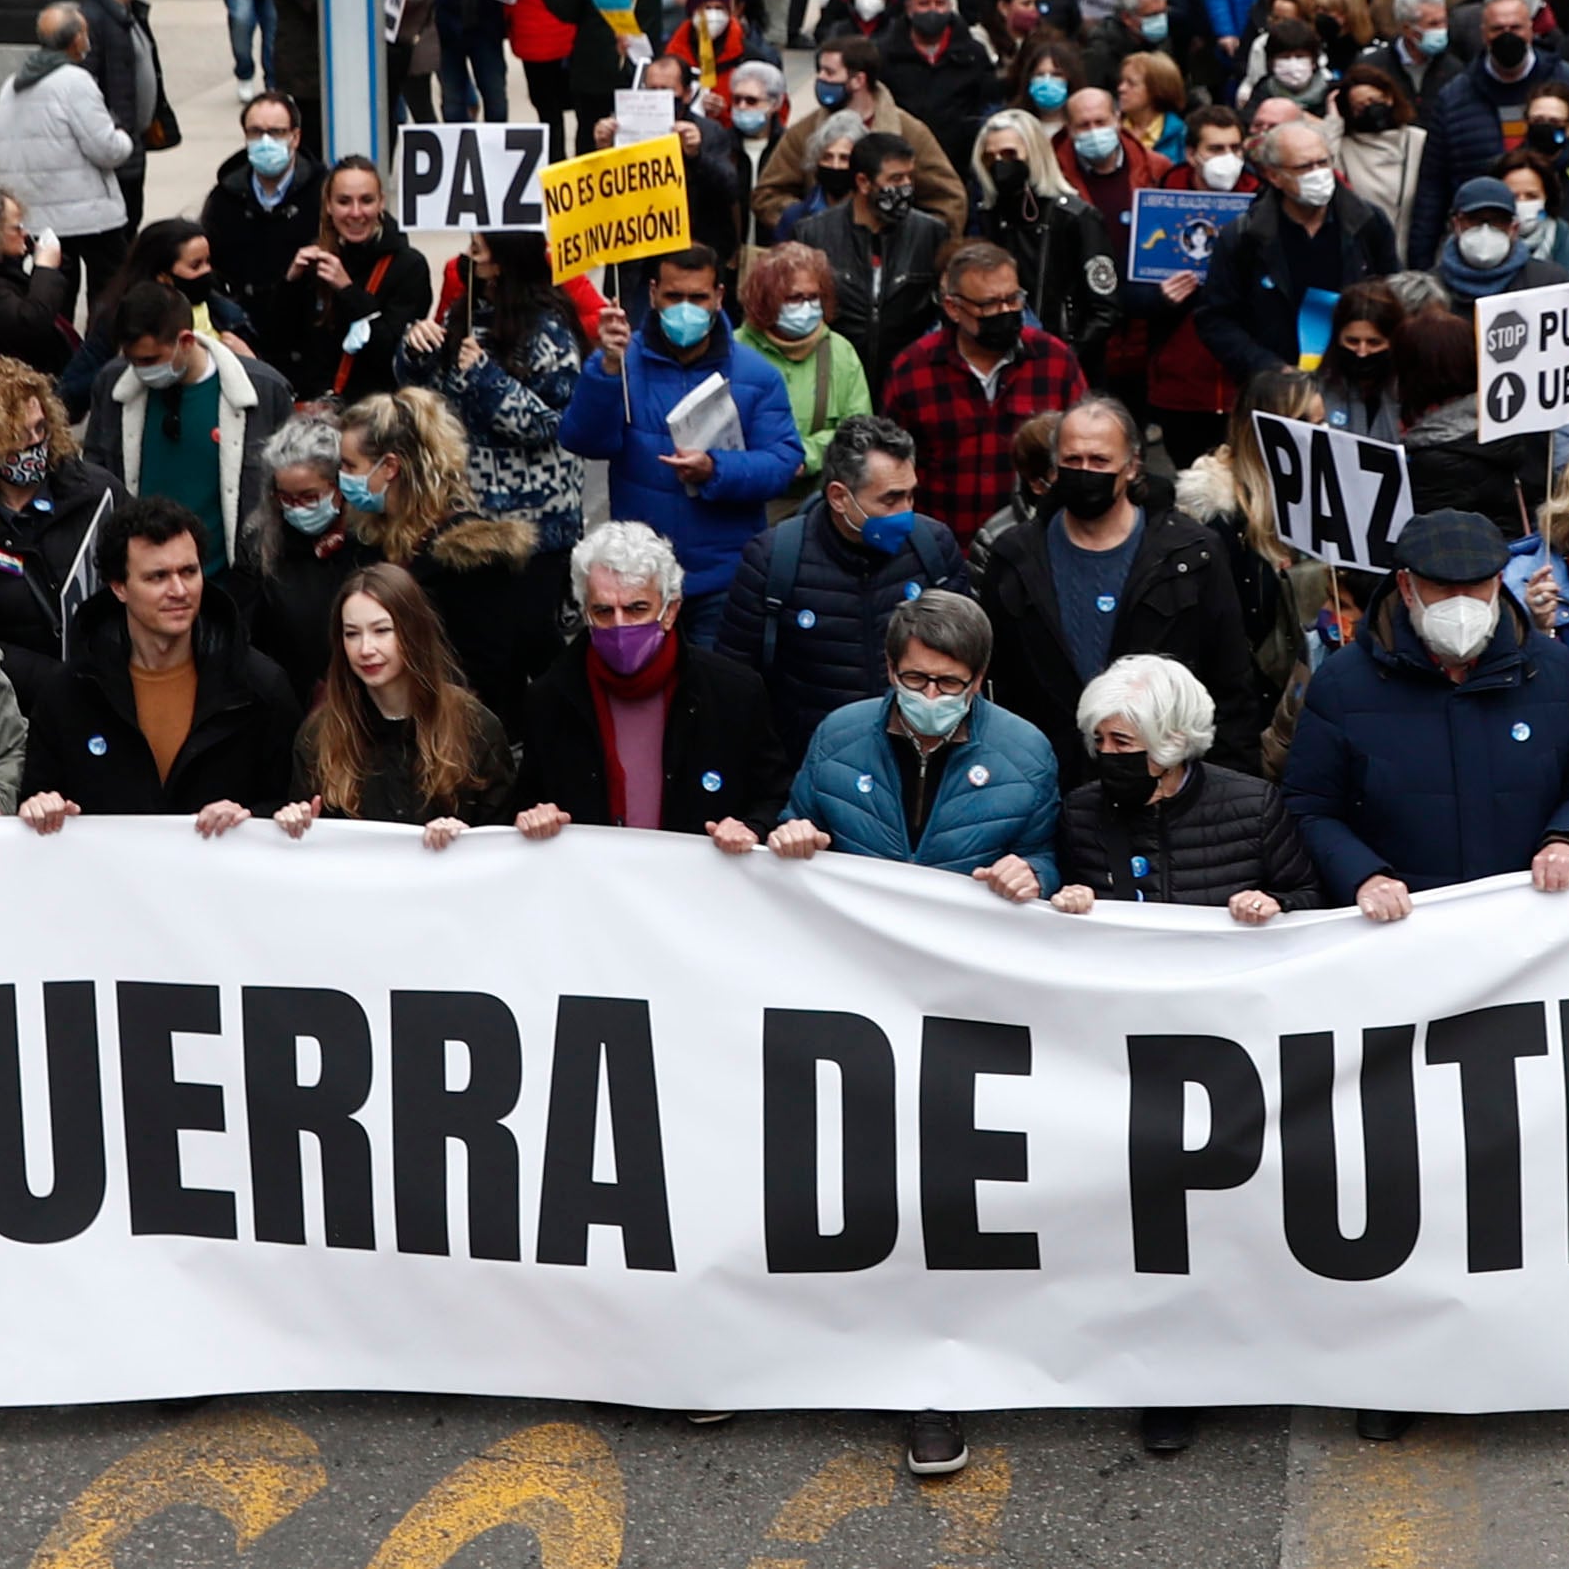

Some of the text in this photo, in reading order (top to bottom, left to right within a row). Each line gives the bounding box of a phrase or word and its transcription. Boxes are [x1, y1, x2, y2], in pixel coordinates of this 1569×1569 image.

[403, 128, 544, 227] PAZ
[545, 155, 683, 217] NO ES GUERRA,
[557, 205, 681, 272] ¡ES INVASIÓN!
[1487, 323, 1527, 352] STOP
[1256, 415, 1403, 569] PAZ
[763, 1006, 1042, 1274] DE
